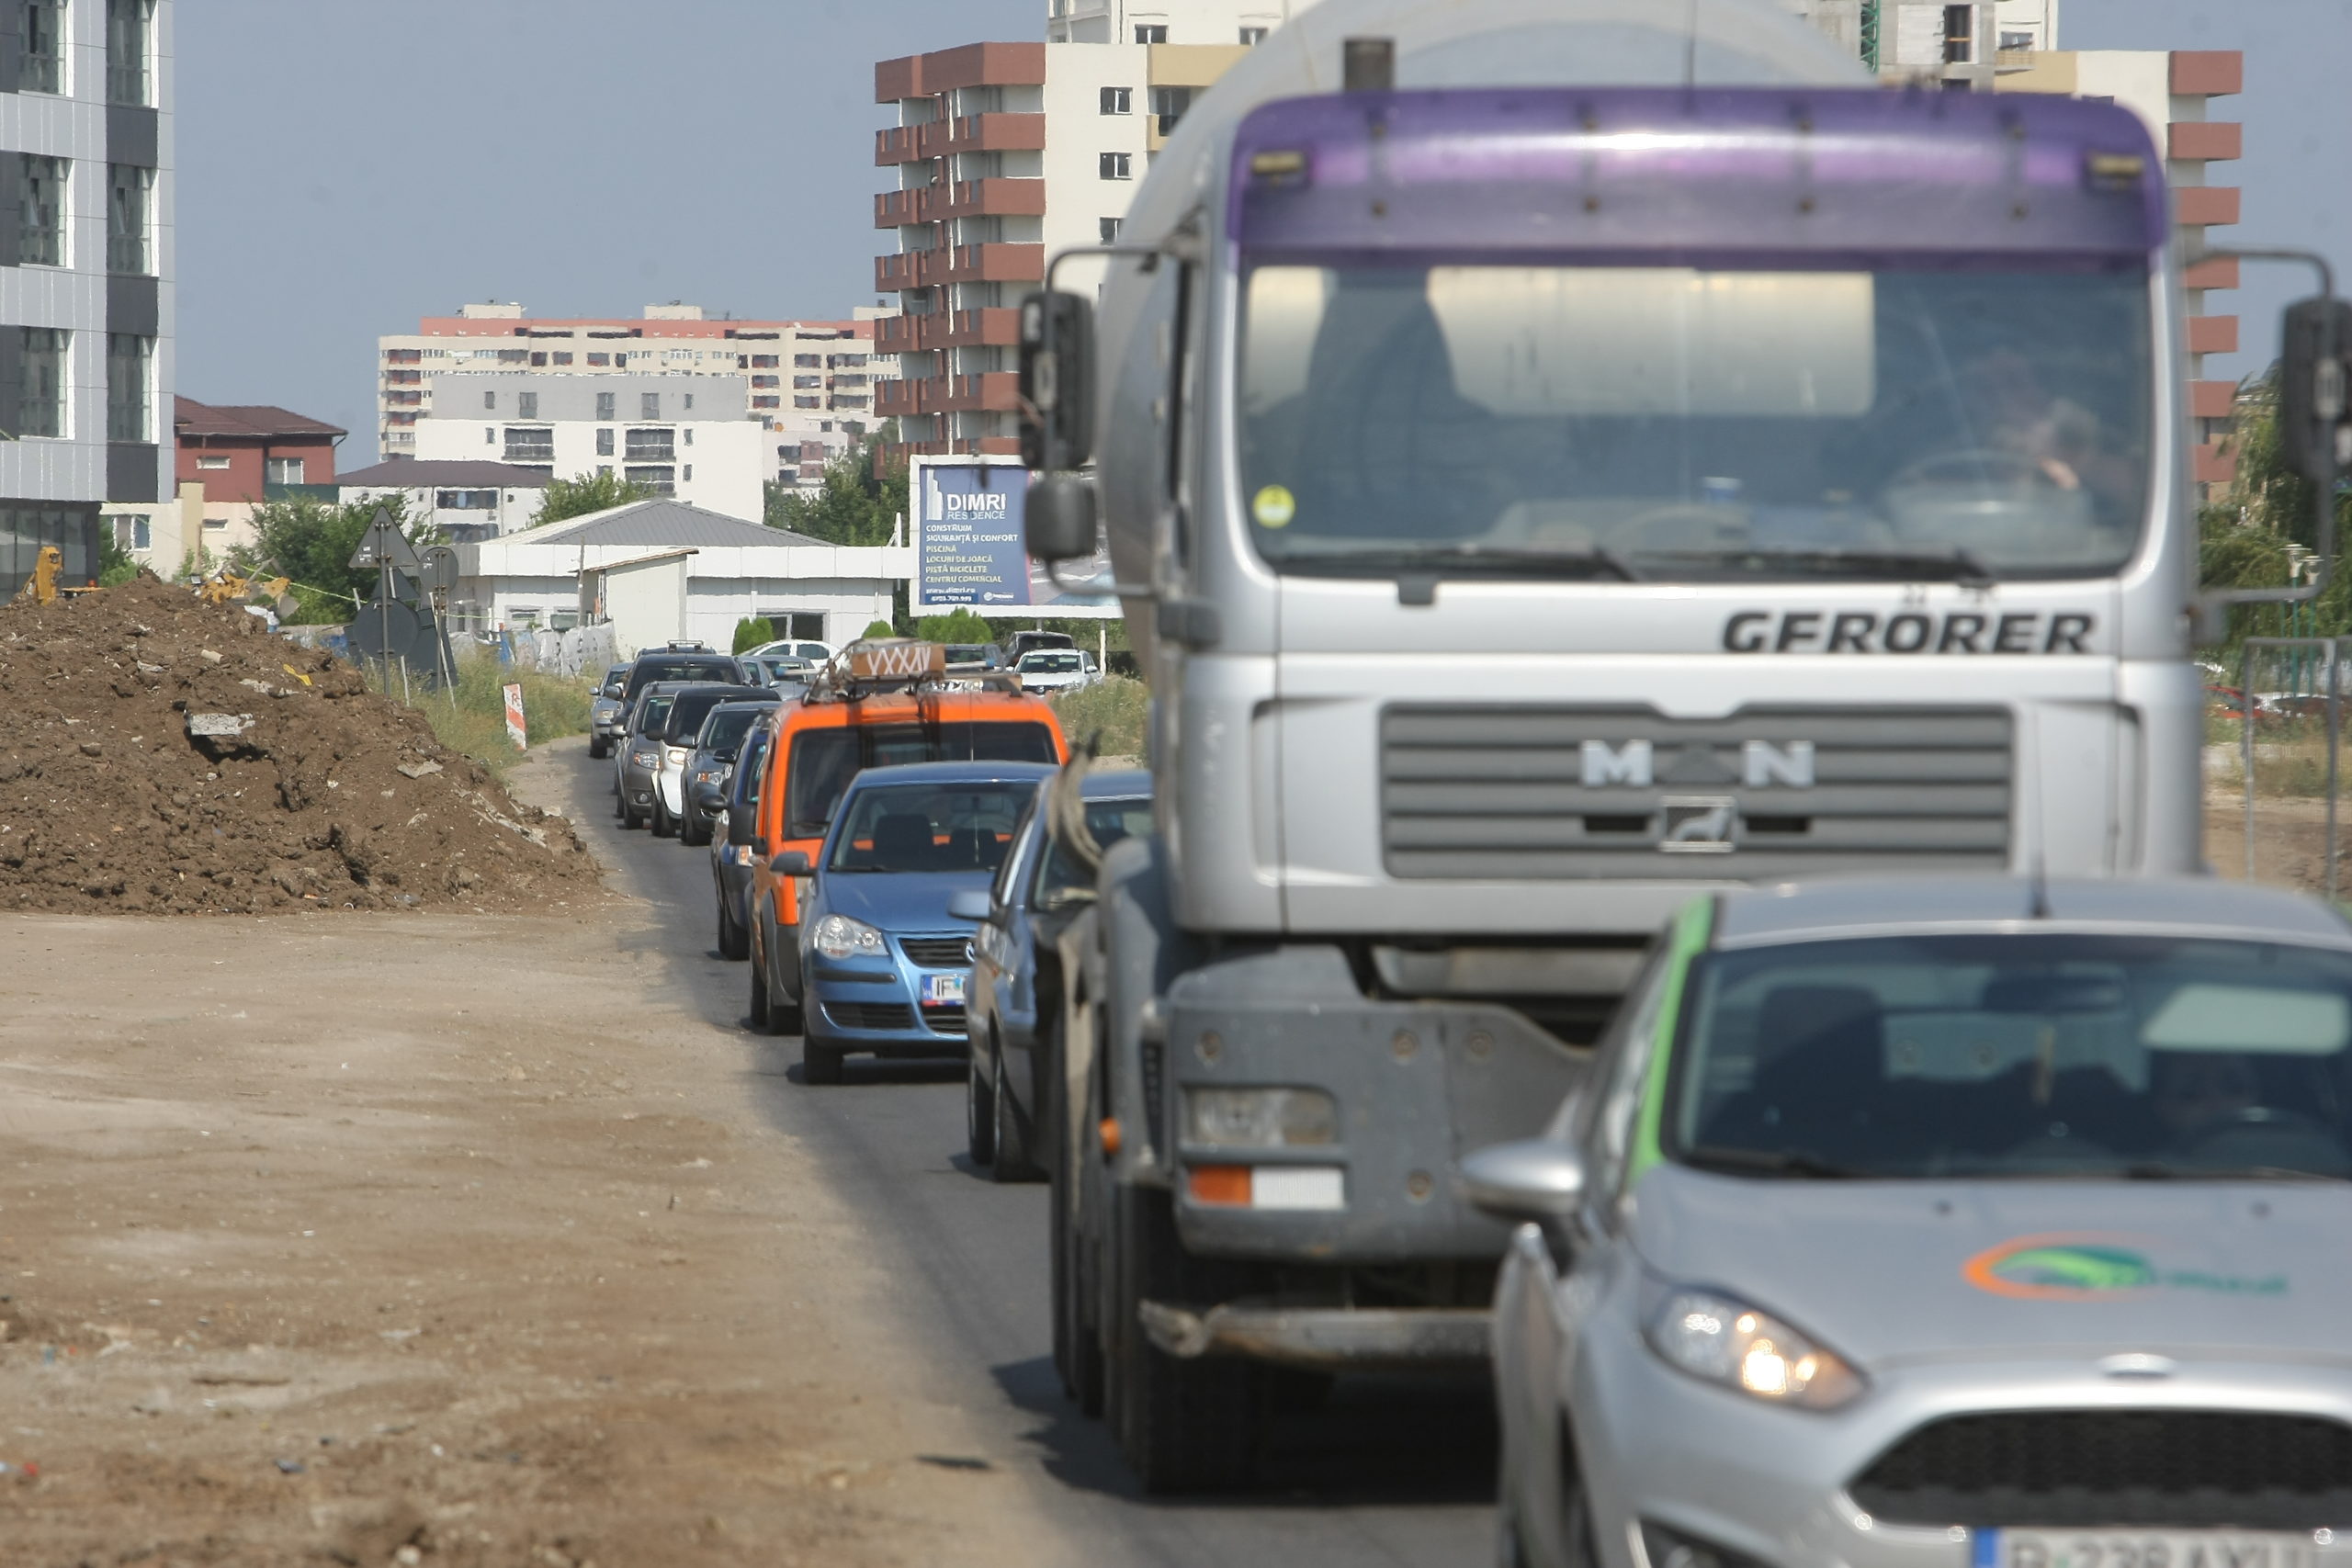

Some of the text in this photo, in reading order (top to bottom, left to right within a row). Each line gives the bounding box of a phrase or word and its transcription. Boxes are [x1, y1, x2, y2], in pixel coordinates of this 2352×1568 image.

[947, 492, 1006, 511] DIMRI
[946, 511, 1006, 521] RESDENCE
[1581, 739, 1815, 787] MN
